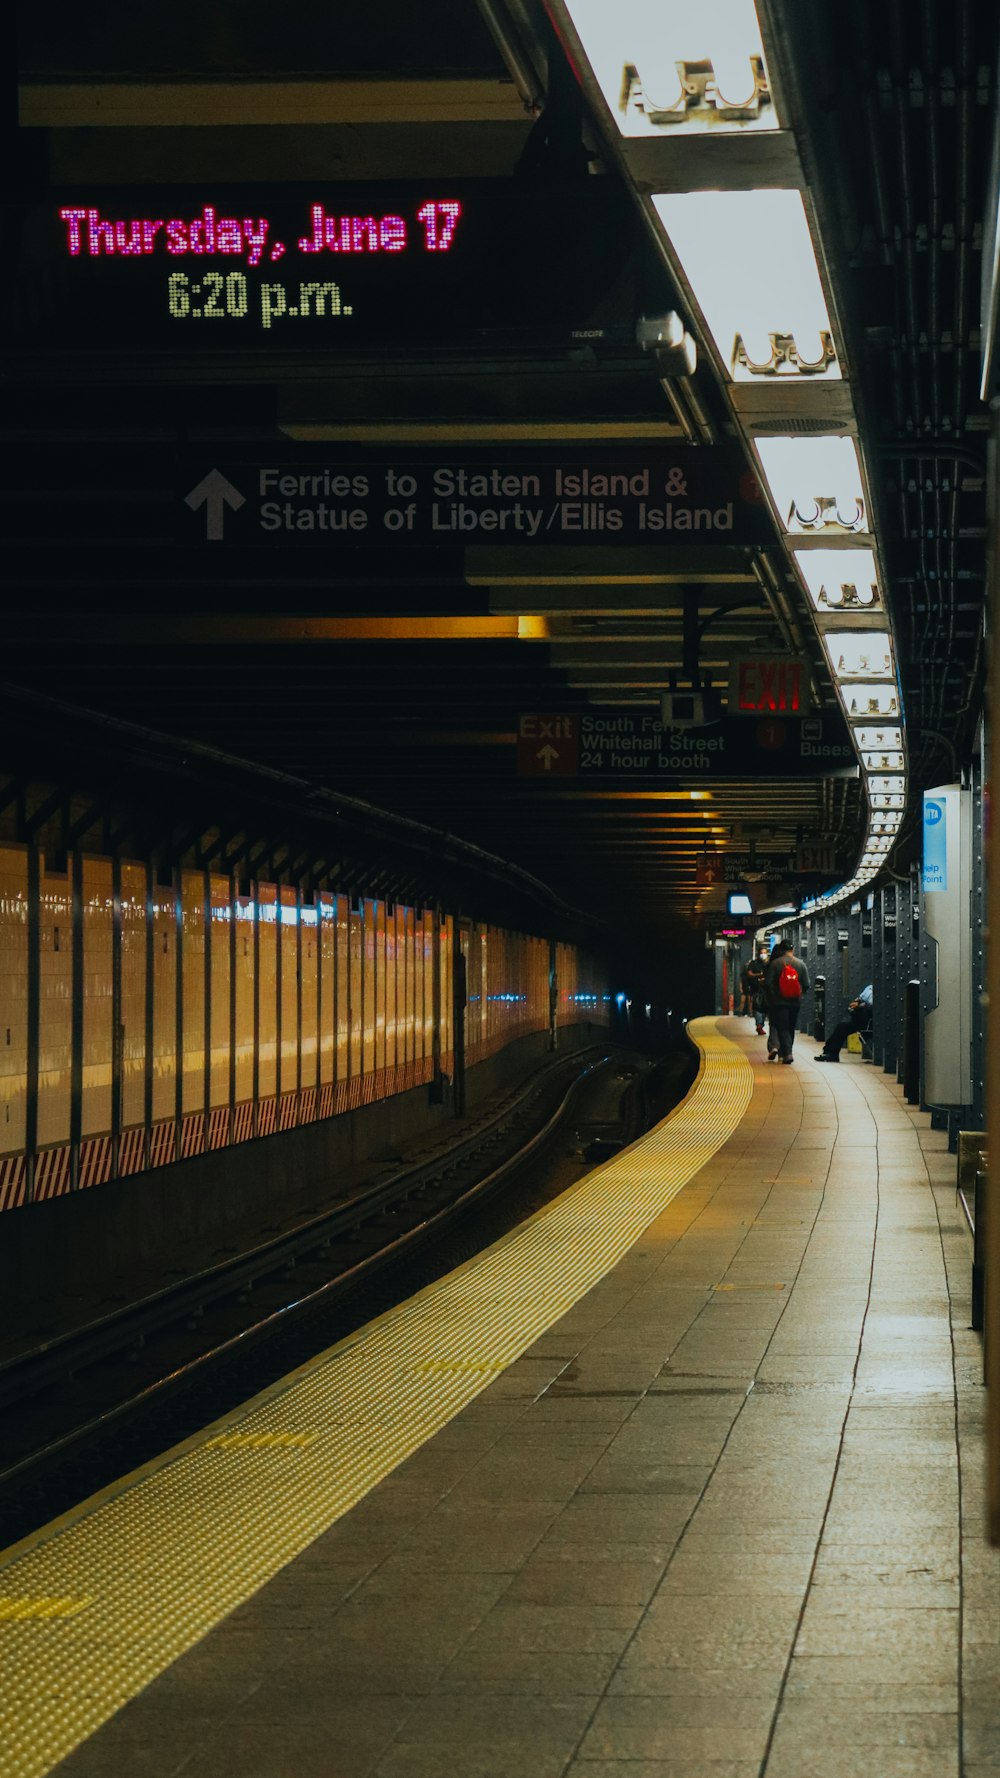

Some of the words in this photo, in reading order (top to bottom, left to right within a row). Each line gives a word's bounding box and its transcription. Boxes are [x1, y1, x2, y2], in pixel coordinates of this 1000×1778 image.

[60, 204, 286, 266] Thursday,
[298, 202, 407, 254] June
[417, 199, 463, 252] 17
[167, 271, 248, 318] 6:20
[260, 280, 354, 329] p.m.
[259, 468, 369, 498] Ferries
[385, 471, 417, 498] to
[432, 468, 540, 498] Staten
[555, 468, 650, 497] Island
[664, 468, 688, 497] &
[259, 503, 369, 531] Statue
[383, 503, 416, 531] of
[431, 502, 624, 537] Liberty/Ellis
[638, 502, 733, 531] Island
[738, 662, 805, 711] EXIT
[519, 716, 572, 739] Exit
[581, 716, 634, 733] South
[581, 735, 661, 751] Whitehall
[669, 735, 725, 751] Street
[800, 742, 851, 757] Buses
[580, 753, 603, 768] 24
[611, 753, 649, 768] hour
[658, 753, 710, 769] booth
